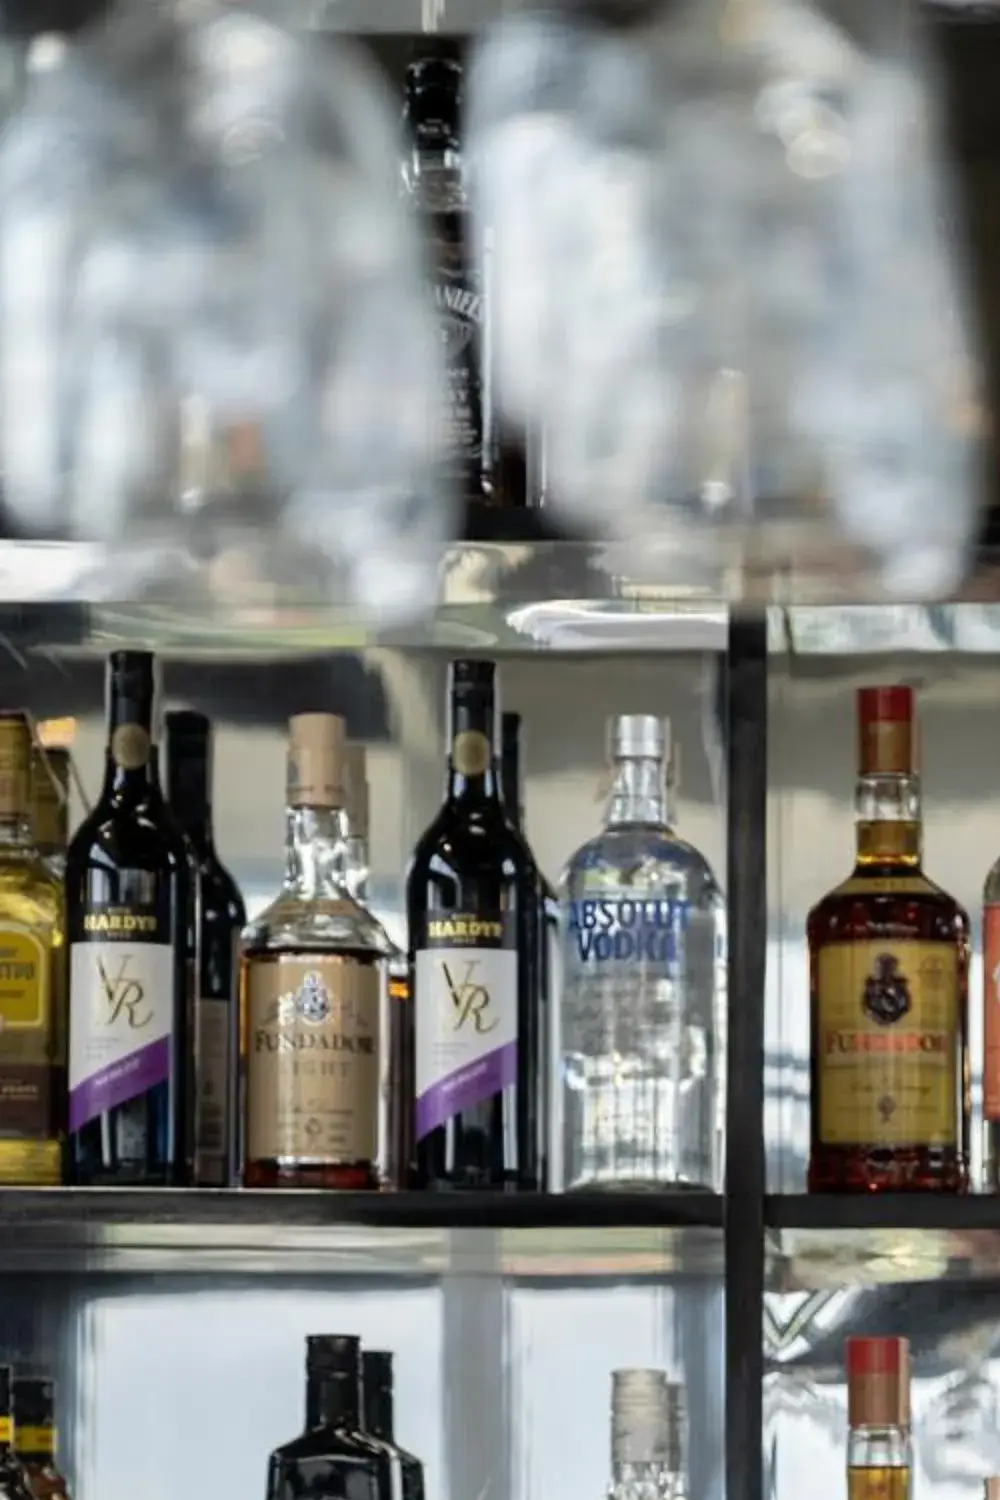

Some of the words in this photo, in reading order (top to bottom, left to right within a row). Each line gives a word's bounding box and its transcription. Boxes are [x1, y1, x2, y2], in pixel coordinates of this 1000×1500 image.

[83, 914, 157, 932] HARDYS
[428, 921, 503, 938] HARDYS
[578, 931, 677, 962] VODKA
[283, 1060, 351, 1078] IGHT
